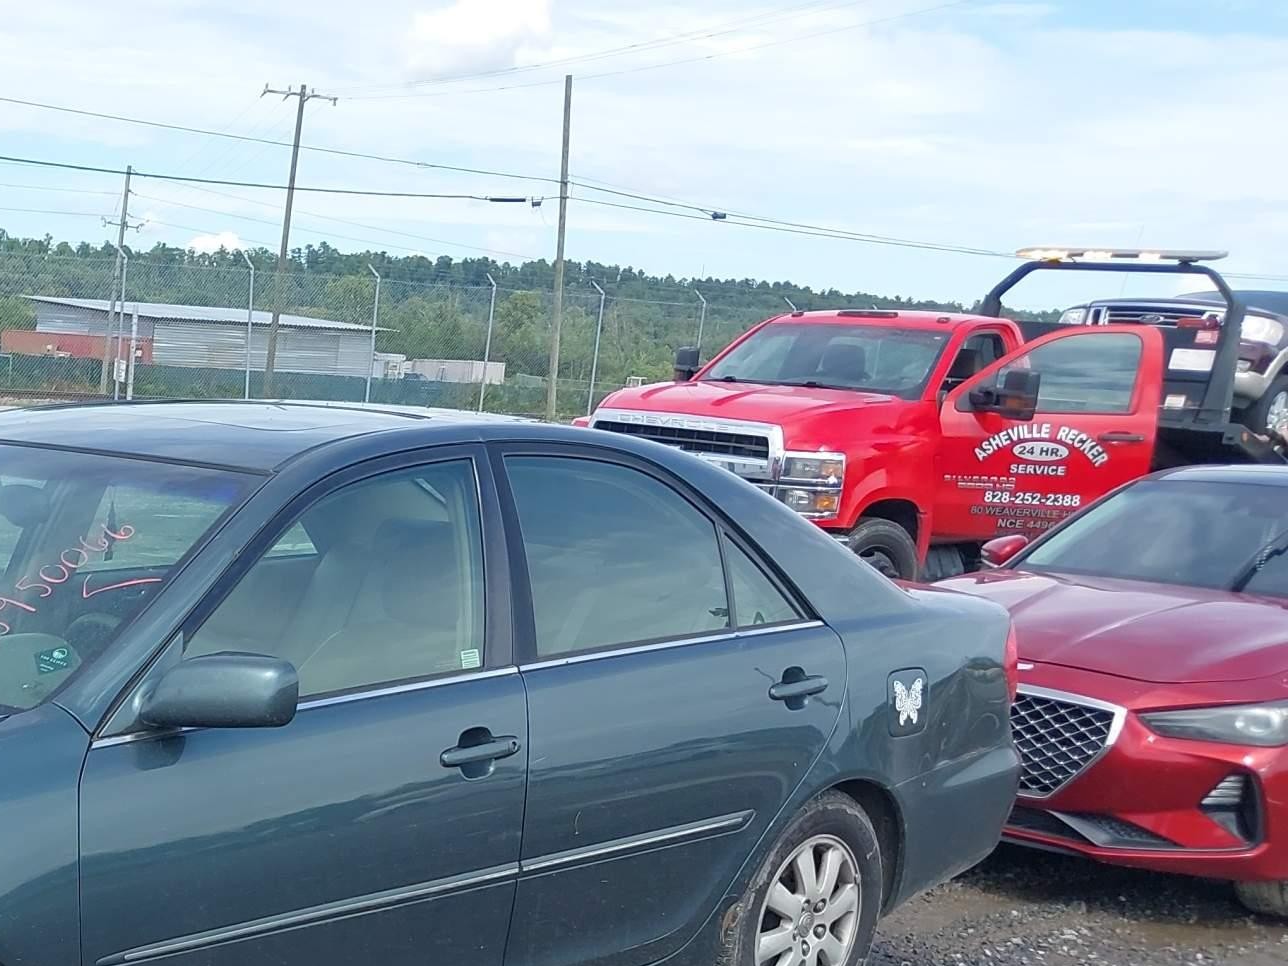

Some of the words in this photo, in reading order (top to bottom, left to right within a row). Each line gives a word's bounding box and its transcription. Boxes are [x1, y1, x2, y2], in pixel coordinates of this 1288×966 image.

[974, 423, 1051, 462] ASHEVILLE
[1056, 426, 1109, 467] RECKER
[1018, 445, 1035, 455] 24
[1039, 446, 1063, 458] HR.
[1009, 463, 1067, 476] SERVICE
[984, 491, 1081, 507] 828-252-2388
[985, 506, 1061, 518] WEAVERVILLE
